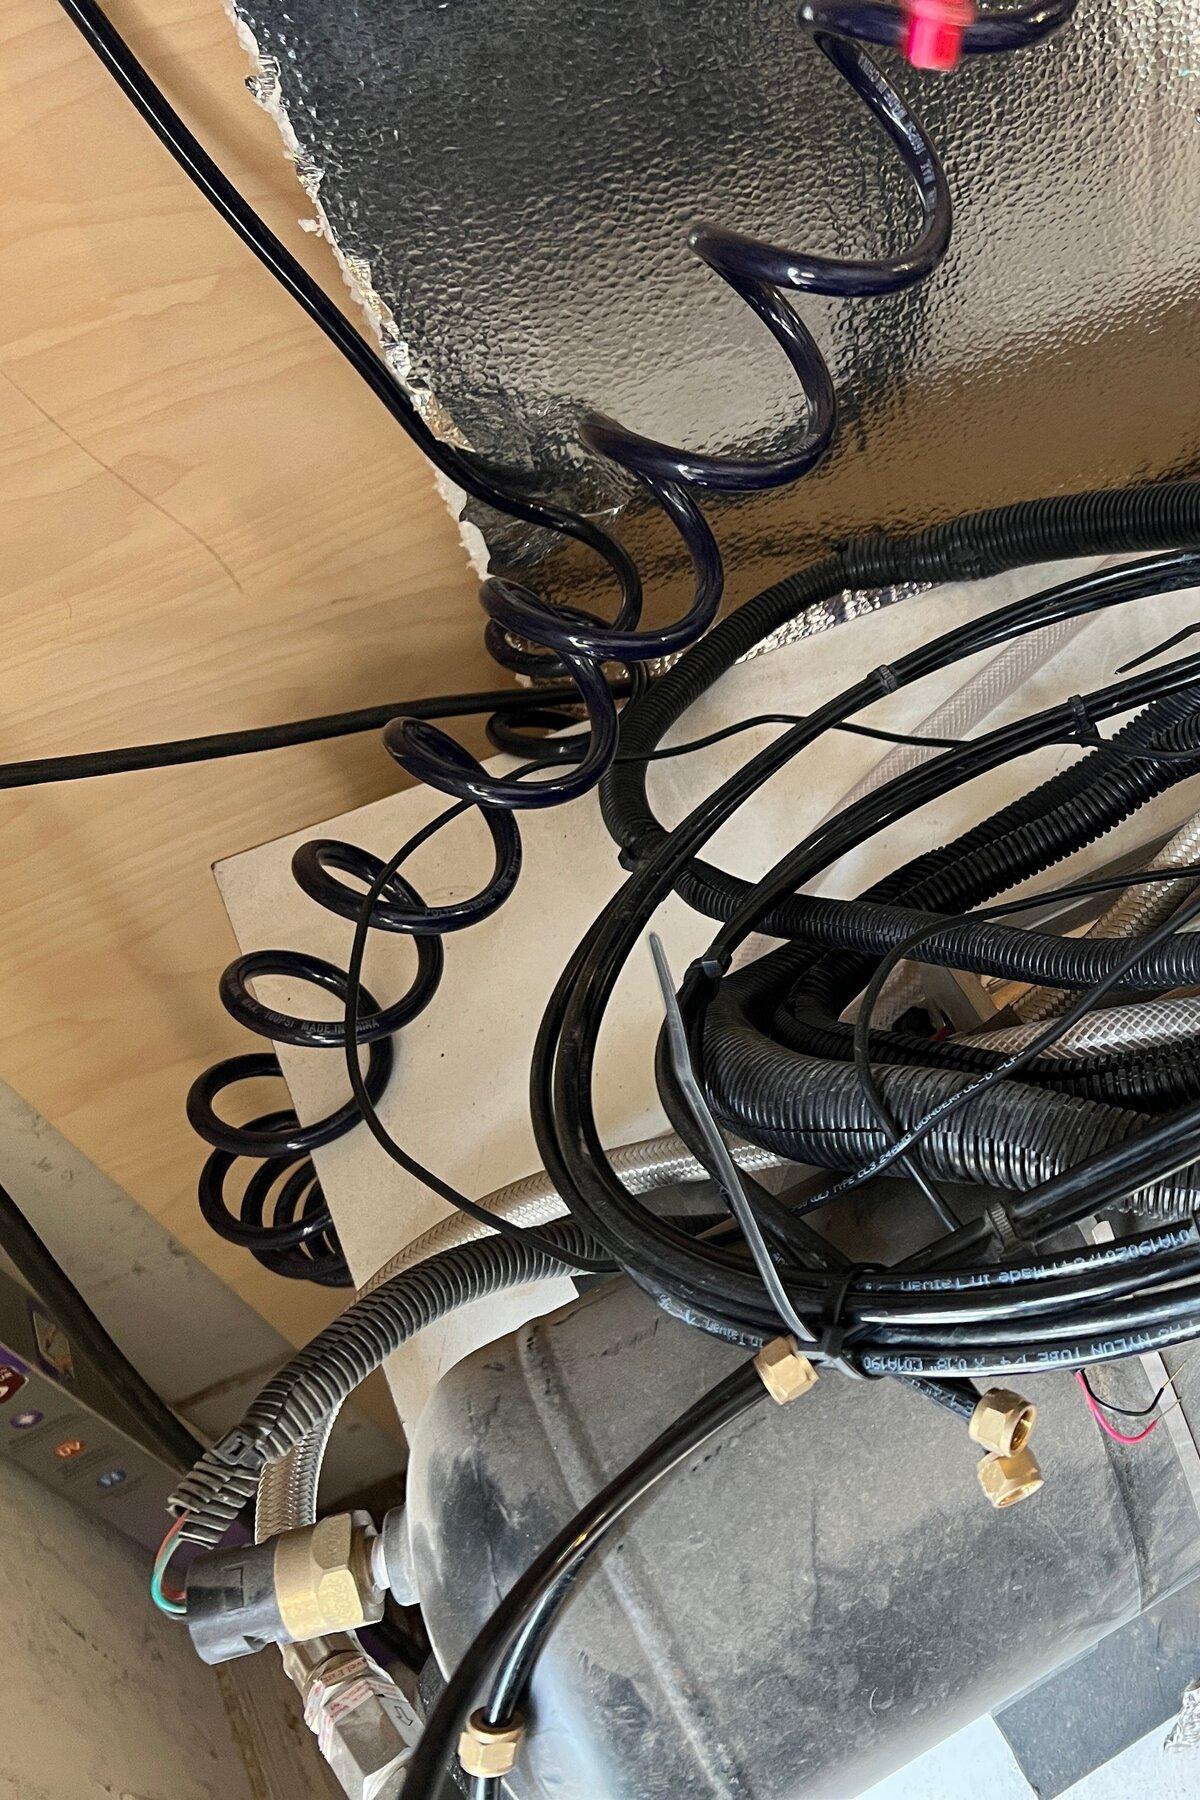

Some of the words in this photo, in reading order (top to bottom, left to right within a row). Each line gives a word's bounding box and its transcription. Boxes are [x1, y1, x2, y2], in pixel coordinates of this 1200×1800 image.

[300, 1022, 331, 1034] MADE
[970, 1274, 989, 1287] in
[998, 1264, 1044, 1285] Made
[899, 1275, 962, 1291] Taiwan
[1036, 1344, 1083, 1362] TUBE
